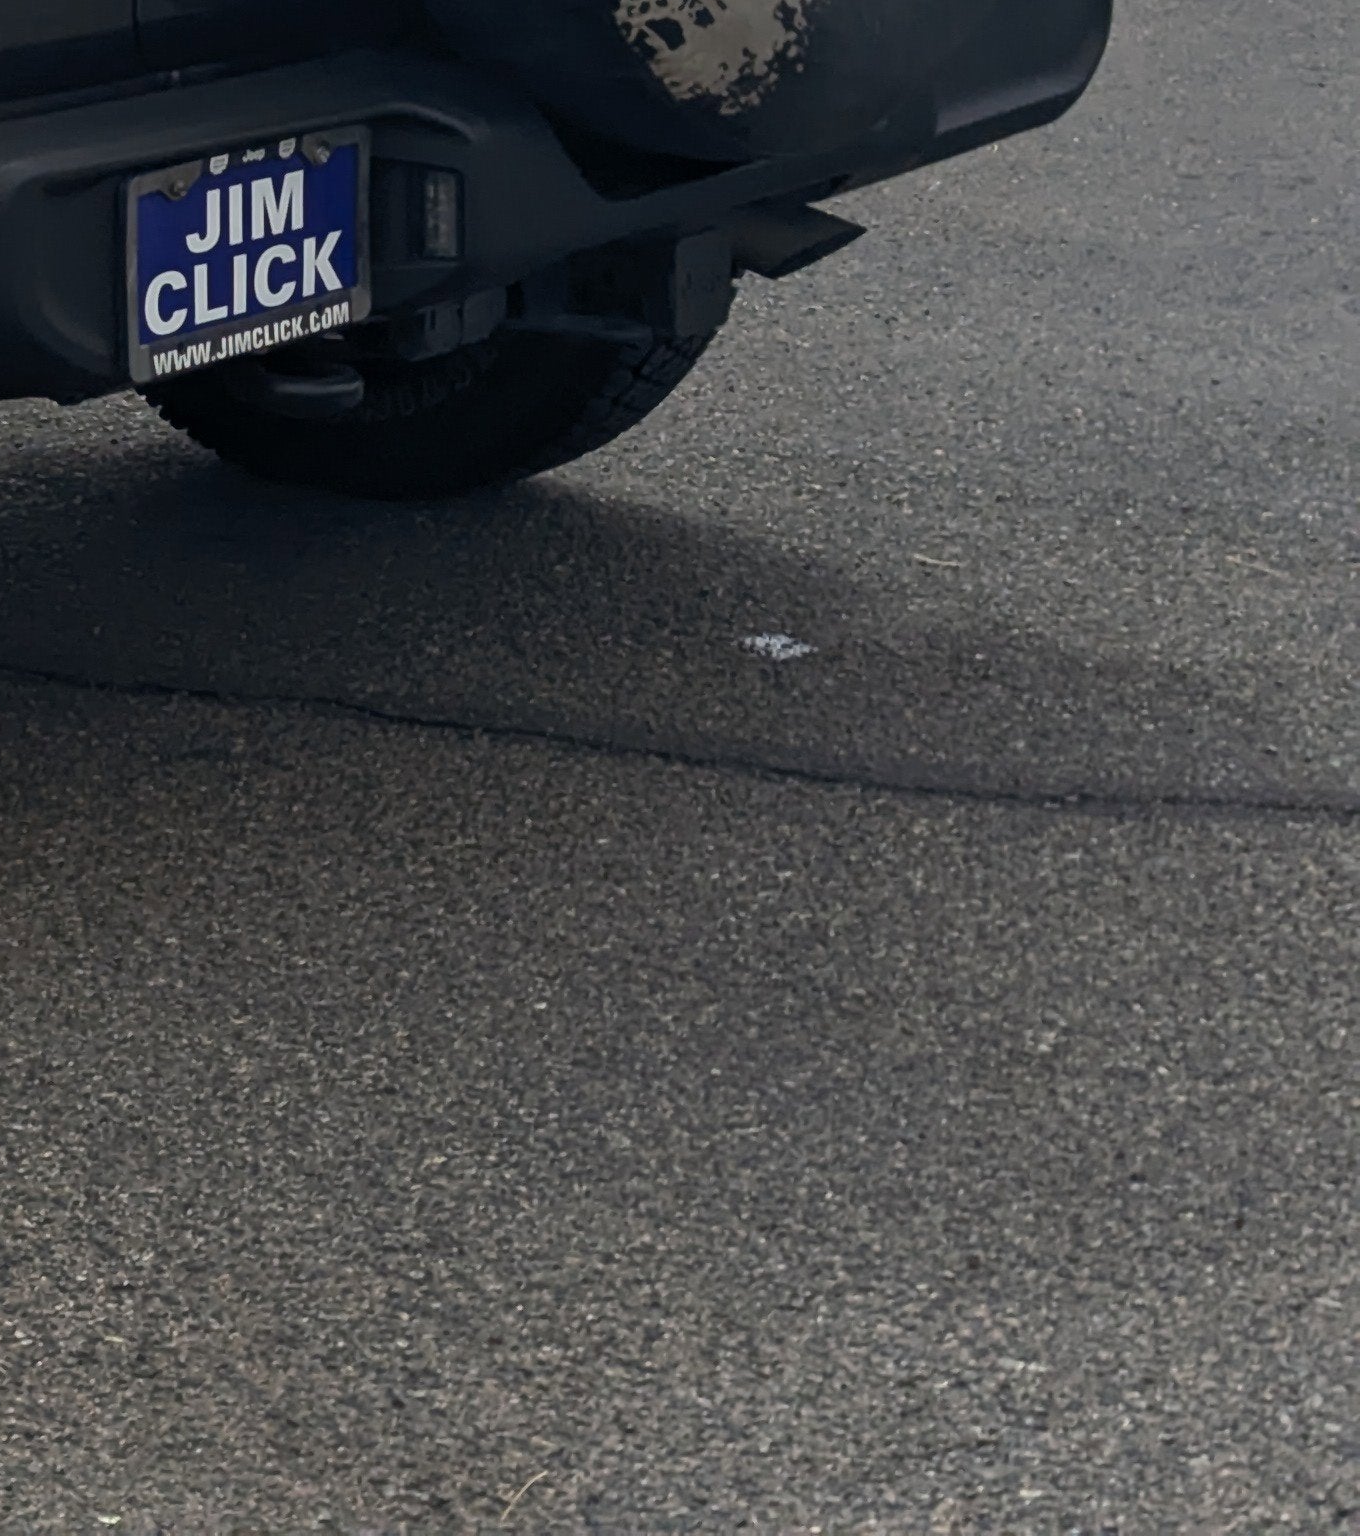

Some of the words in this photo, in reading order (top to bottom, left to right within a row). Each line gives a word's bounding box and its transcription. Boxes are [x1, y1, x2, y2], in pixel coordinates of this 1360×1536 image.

[186, 169, 305, 254] JIM
[144, 230, 343, 337] CLICK
[152, 301, 351, 376] WWW.JIMCLICK.COM
